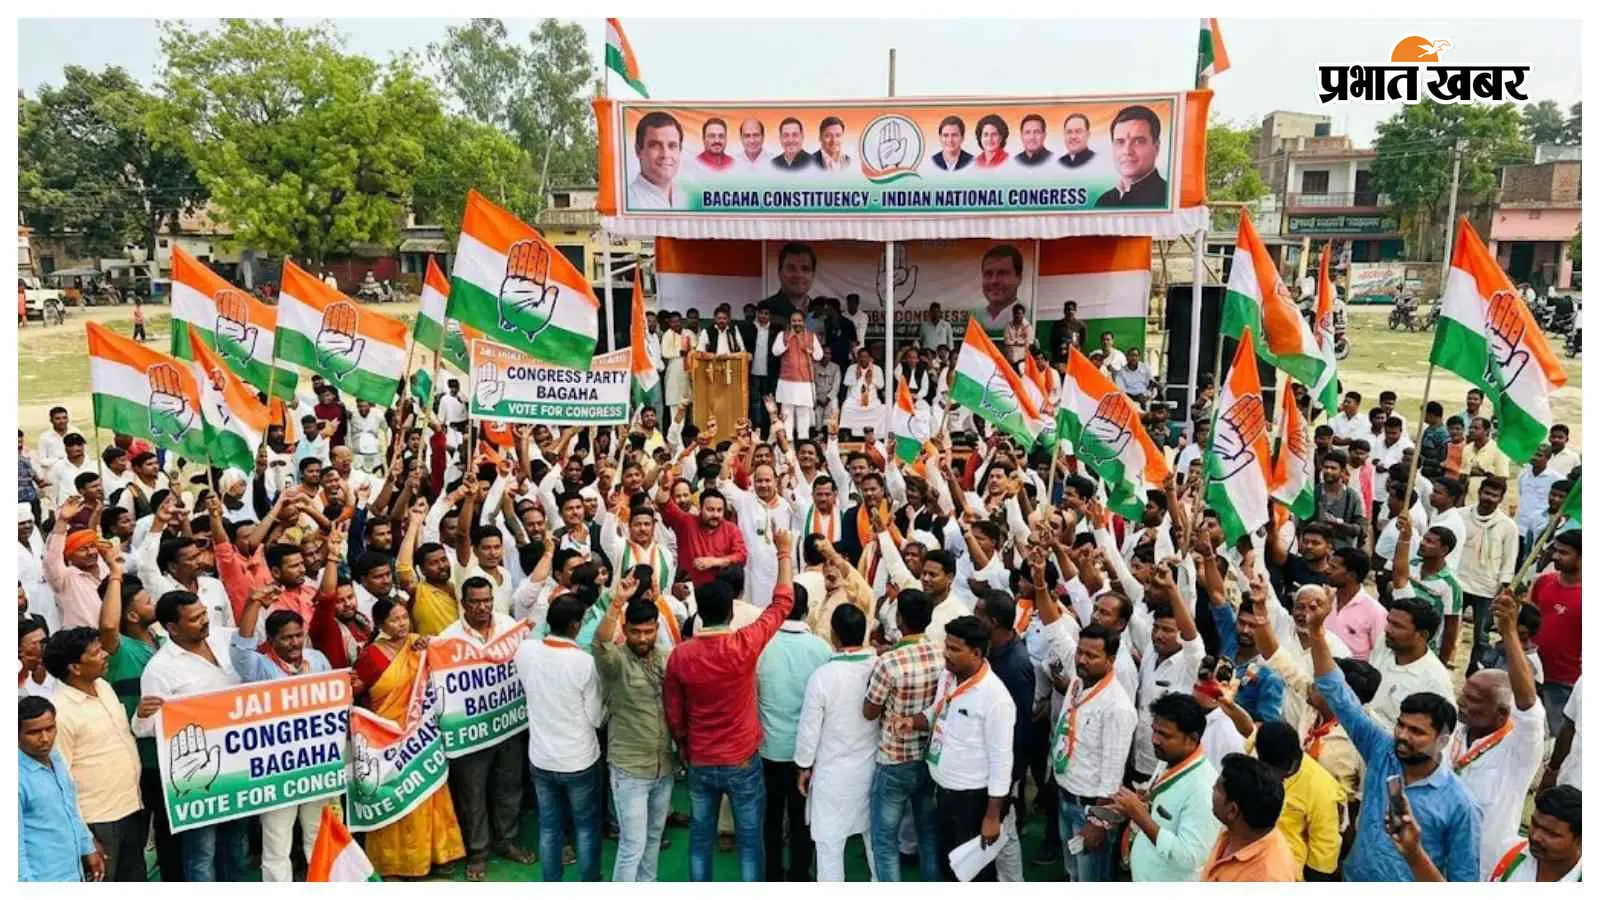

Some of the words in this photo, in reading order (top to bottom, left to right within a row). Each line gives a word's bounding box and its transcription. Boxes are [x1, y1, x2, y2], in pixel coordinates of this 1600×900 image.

[703, 191, 759, 207] BAGAHA
[763, 191, 869, 207] CONSTITUENCY
[882, 190, 931, 207] INDIAN
[935, 189, 1003, 206] NATIONAL
[1008, 188, 1087, 205] CONGRESS
[507, 366, 582, 384] CONGRESS
[585, 370, 627, 384] PARTY
[536, 385, 599, 401] BAGAHA
[508, 403, 537, 416] VOTE
[541, 405, 562, 416] FOR
[565, 404, 622, 417] CONGRESS
[445, 660, 518, 694] CONGRE
[228, 690, 272, 720] JAI
[280, 679, 345, 711] HIND
[464, 678, 526, 717] BAGAHA
[225, 710, 349, 754] CONGRESS
[459, 721, 489, 745] FOR
[492, 704, 528, 733] CONG
[250, 742, 341, 779] BAGAHA
[175, 793, 230, 821] VOTE
[236, 784, 277, 808] FOR
[283, 769, 347, 798] CONGR
[354, 797, 396, 820] VOTE
[395, 770, 426, 802] FOR
